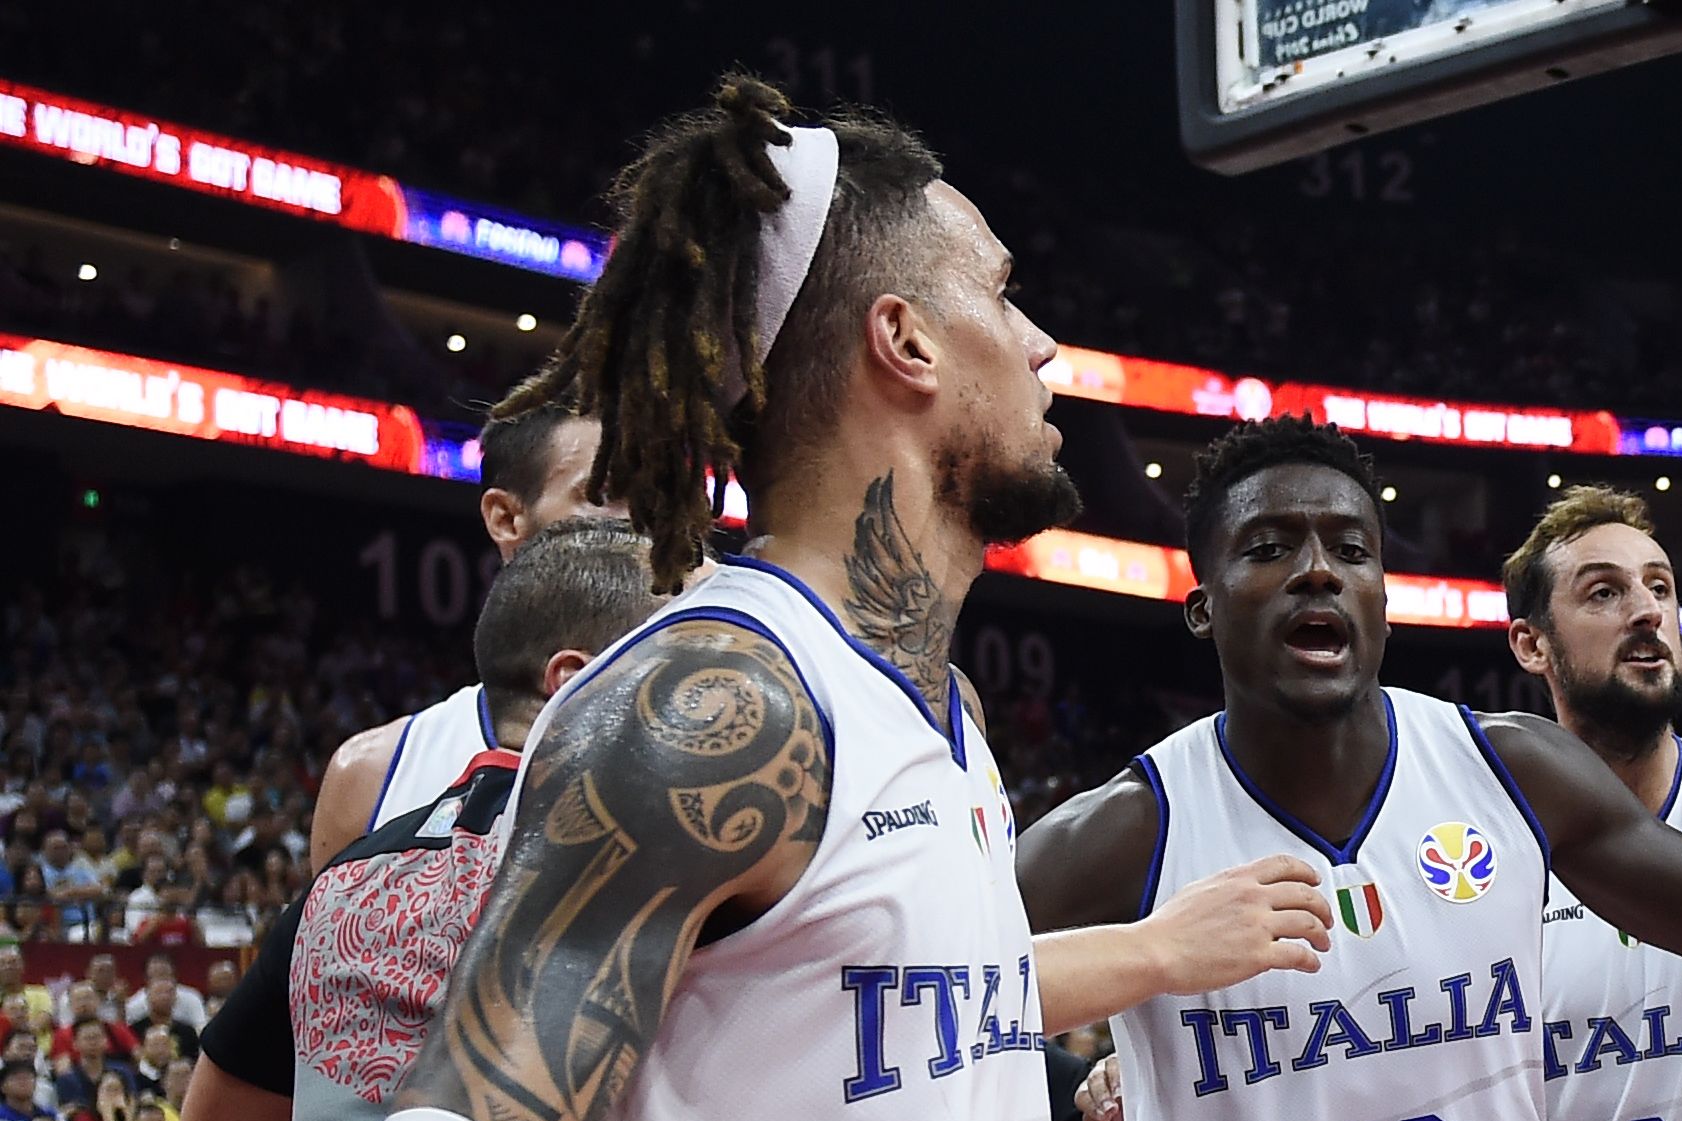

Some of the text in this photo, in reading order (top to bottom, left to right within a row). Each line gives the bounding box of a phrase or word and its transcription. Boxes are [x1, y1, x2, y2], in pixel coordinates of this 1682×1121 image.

[950, 622, 1057, 697] 09
[861, 799, 939, 842] SPALDING
[1180, 957, 1533, 1098] ITALIA
